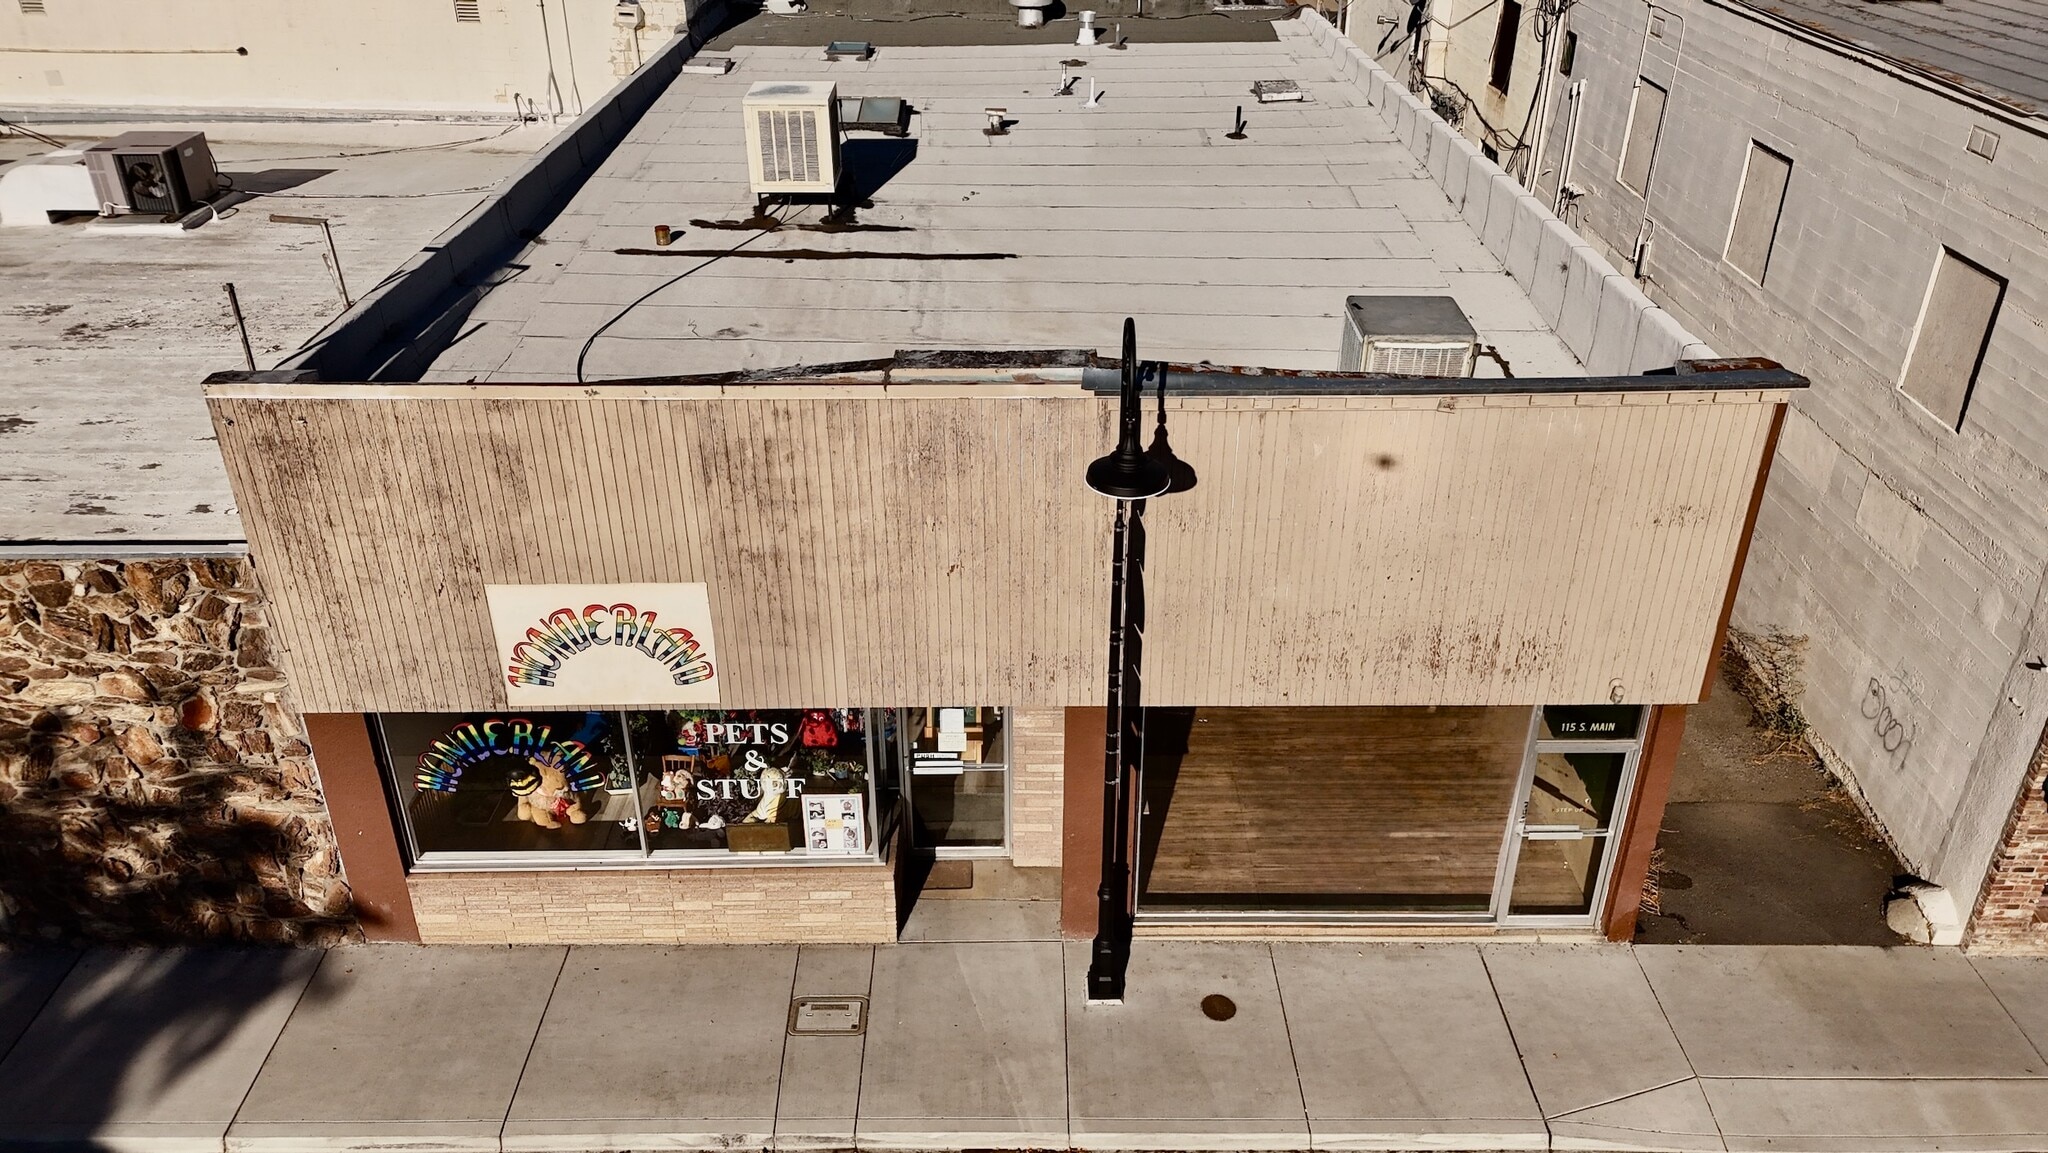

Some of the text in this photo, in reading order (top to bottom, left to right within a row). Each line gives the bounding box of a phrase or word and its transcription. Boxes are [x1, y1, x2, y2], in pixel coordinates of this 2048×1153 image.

[508, 603, 714, 688] WONDERLAND
[704, 723, 789, 745] PETS
[1561, 722, 1616, 732] 115 S. MAIN
[413, 718, 606, 793] WONDERLAND
[744, 749, 768, 772] &
